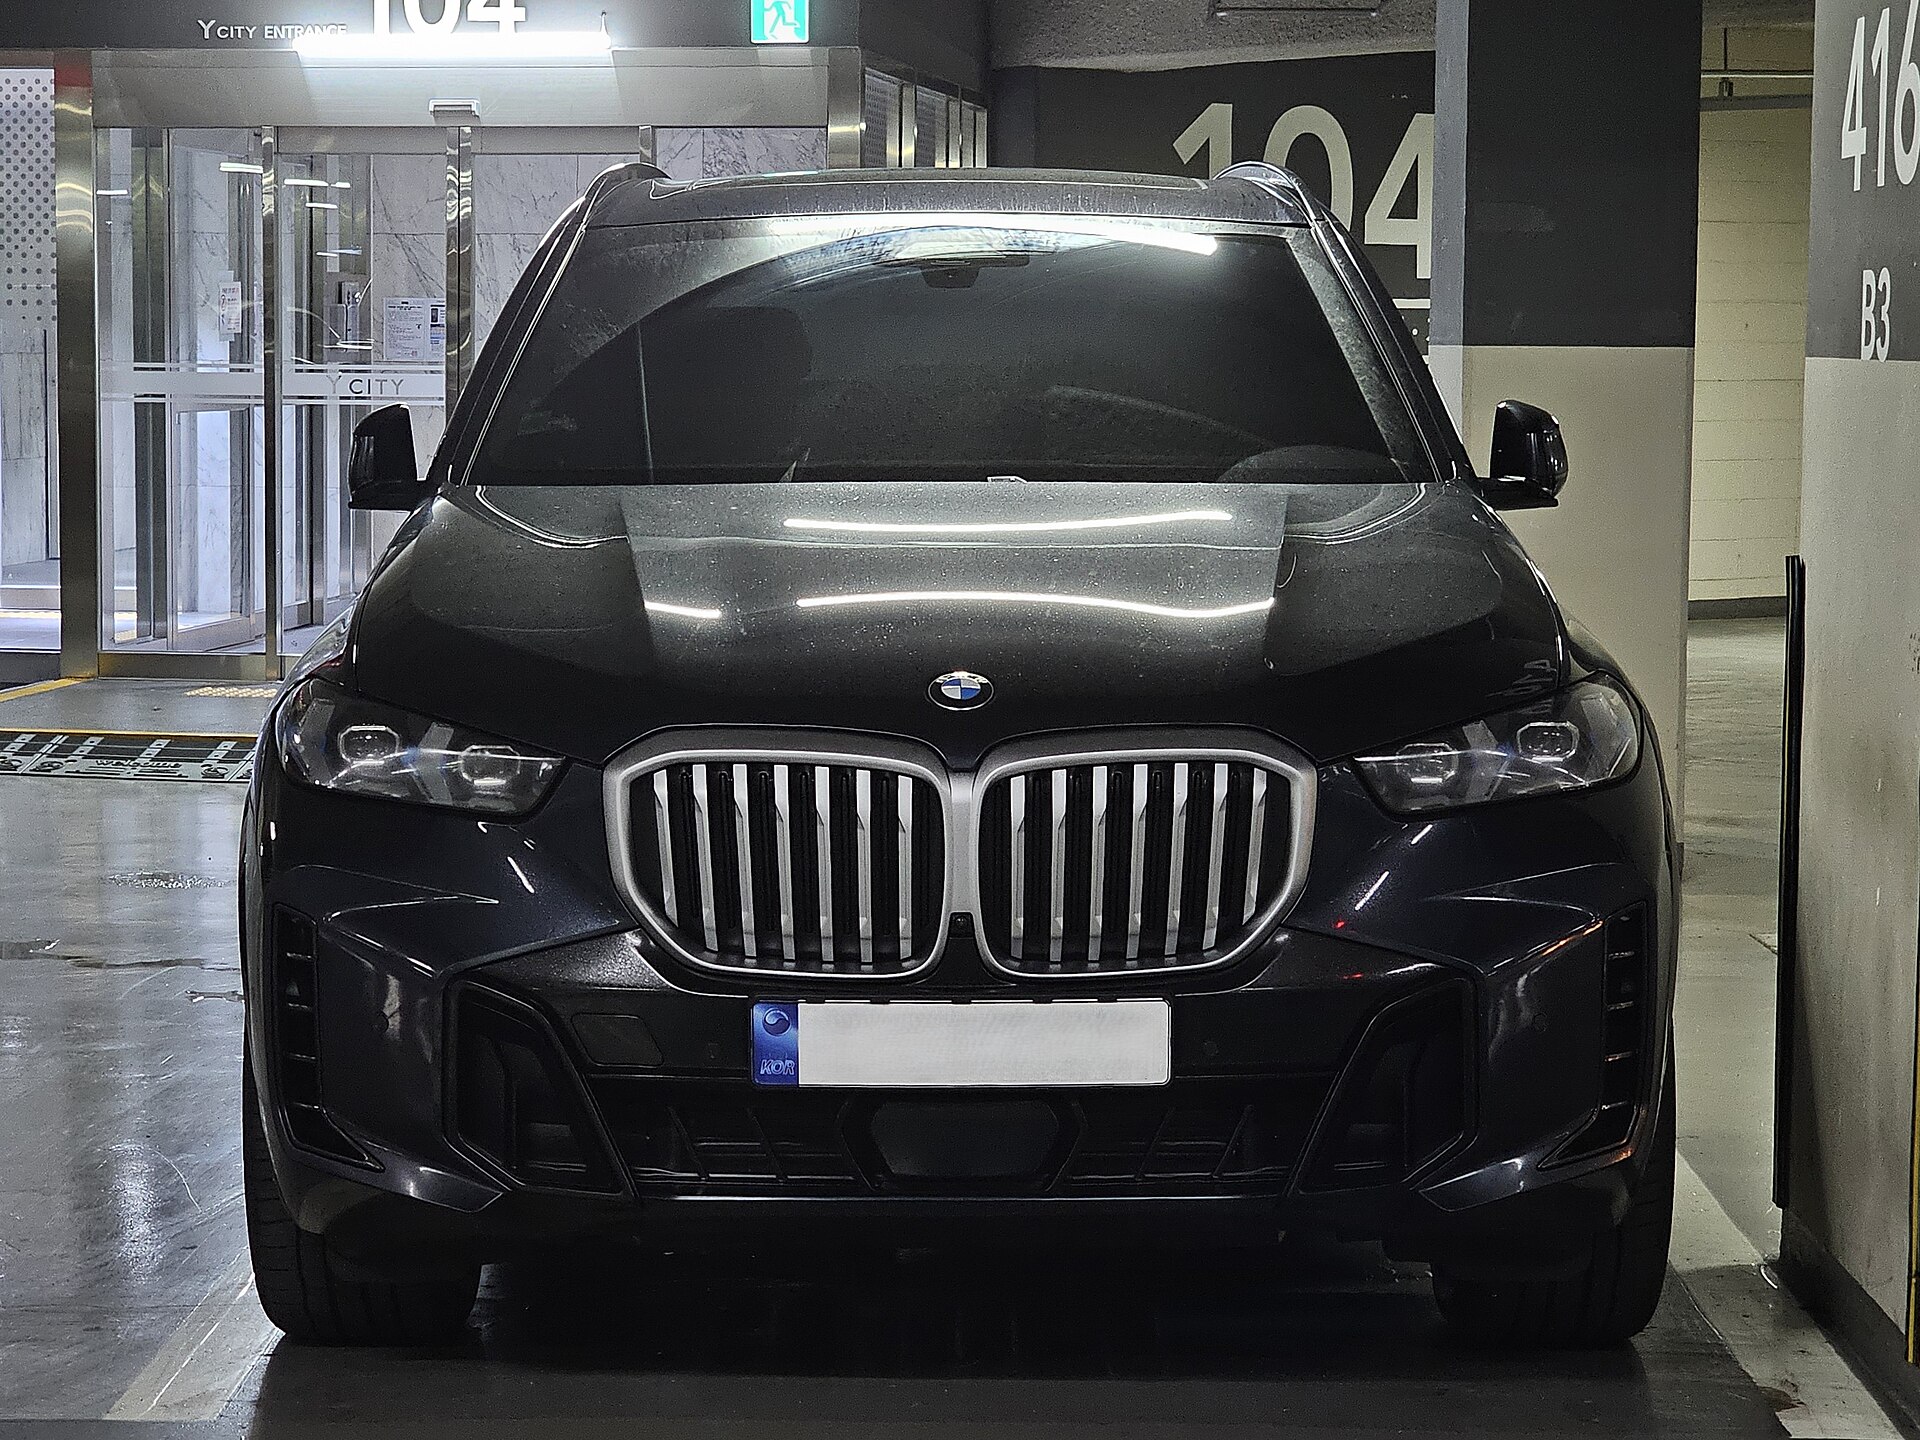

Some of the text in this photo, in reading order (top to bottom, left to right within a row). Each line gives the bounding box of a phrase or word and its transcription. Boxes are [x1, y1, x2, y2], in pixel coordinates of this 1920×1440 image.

[264, 23, 348, 39] ENTRANCE
[1841, 0, 1920, 191] 416
[1860, 266, 1891, 363] B3
[348, 378, 404, 395] CITY
[759, 1059, 796, 1075] KOR
